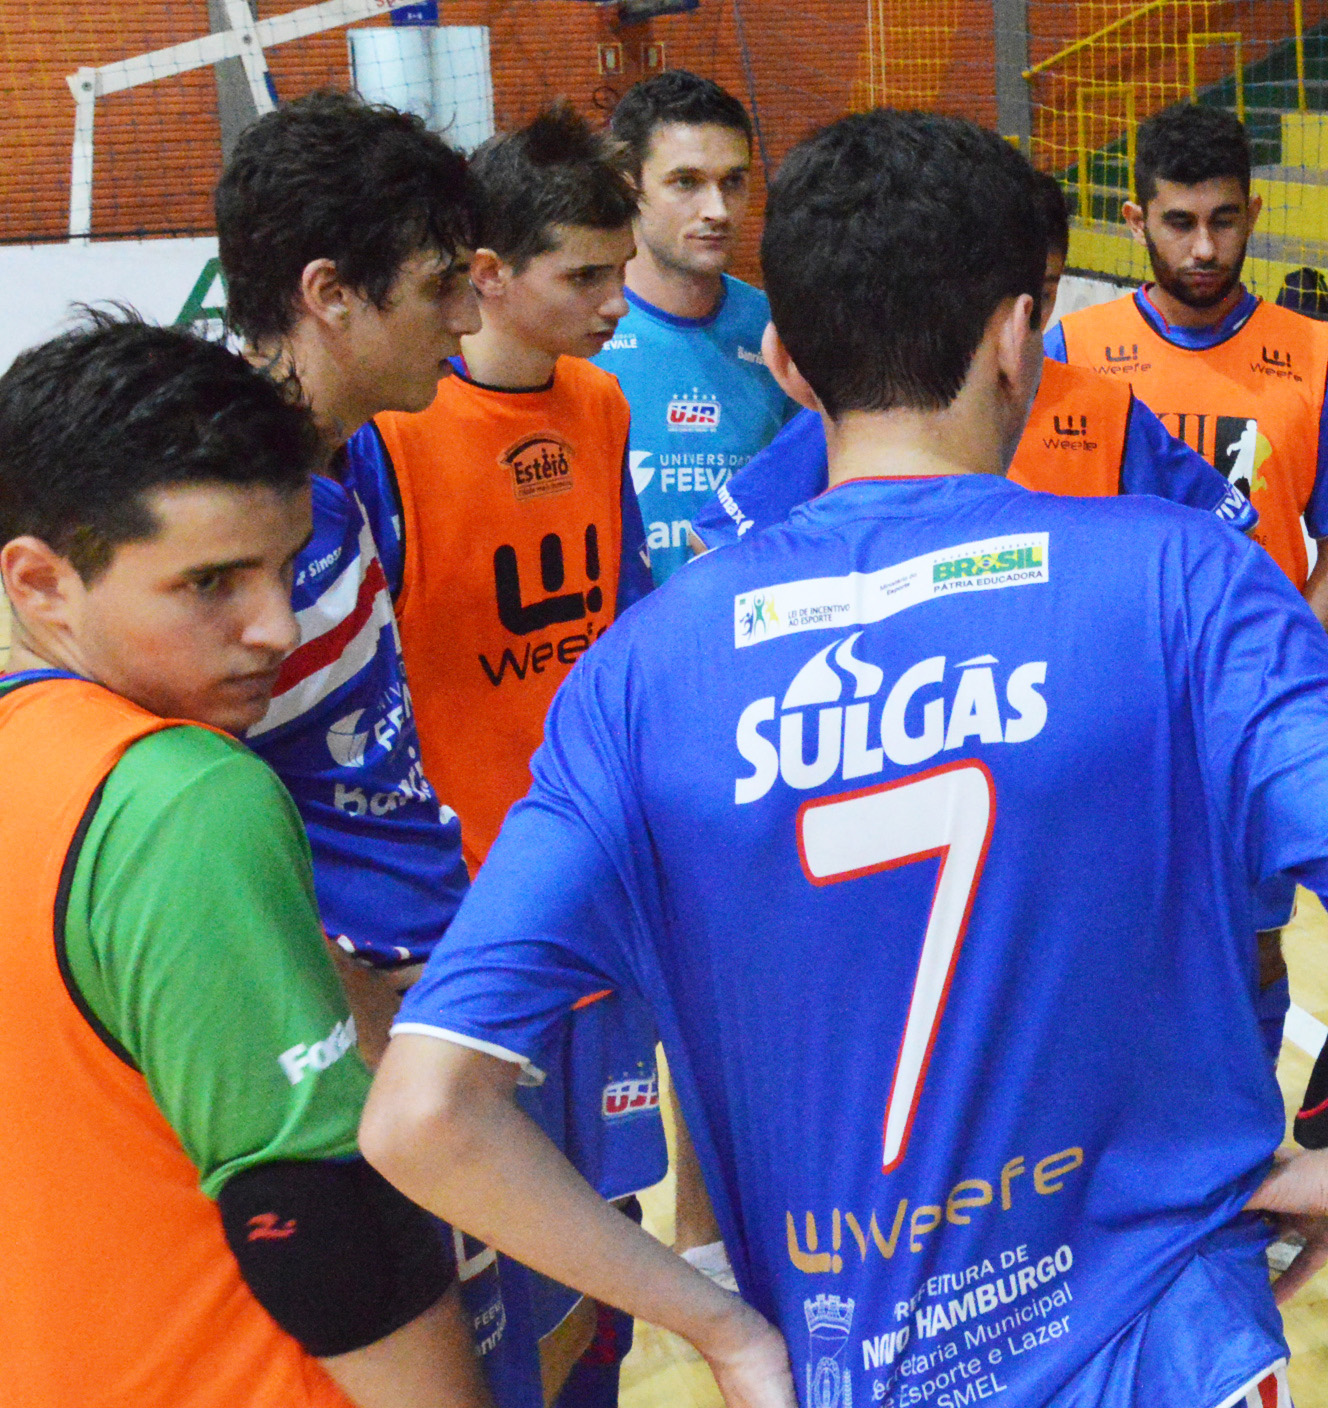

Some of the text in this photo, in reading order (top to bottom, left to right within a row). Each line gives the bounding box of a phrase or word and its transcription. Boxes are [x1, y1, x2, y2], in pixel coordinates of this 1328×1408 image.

[602, 338, 638, 350] EVALE
[669, 404, 716, 424] UJR
[1157, 413, 1211, 456] II
[660, 467, 733, 493] FEEV
[933, 547, 1043, 584] BRASIL
[976, 570, 1043, 586] EDUCADORA
[795, 757, 996, 1175] 7
[604, 1084, 659, 1115] UJ
[1000, 1244, 1030, 1270] DE
[915, 1244, 1074, 1340] HAMBURGO
[963, 1281, 1074, 1350] Municipal
[988, 1348, 1003, 1365] e
[1007, 1315, 1071, 1356] Lazer
[936, 1372, 1008, 1408] SMEL
